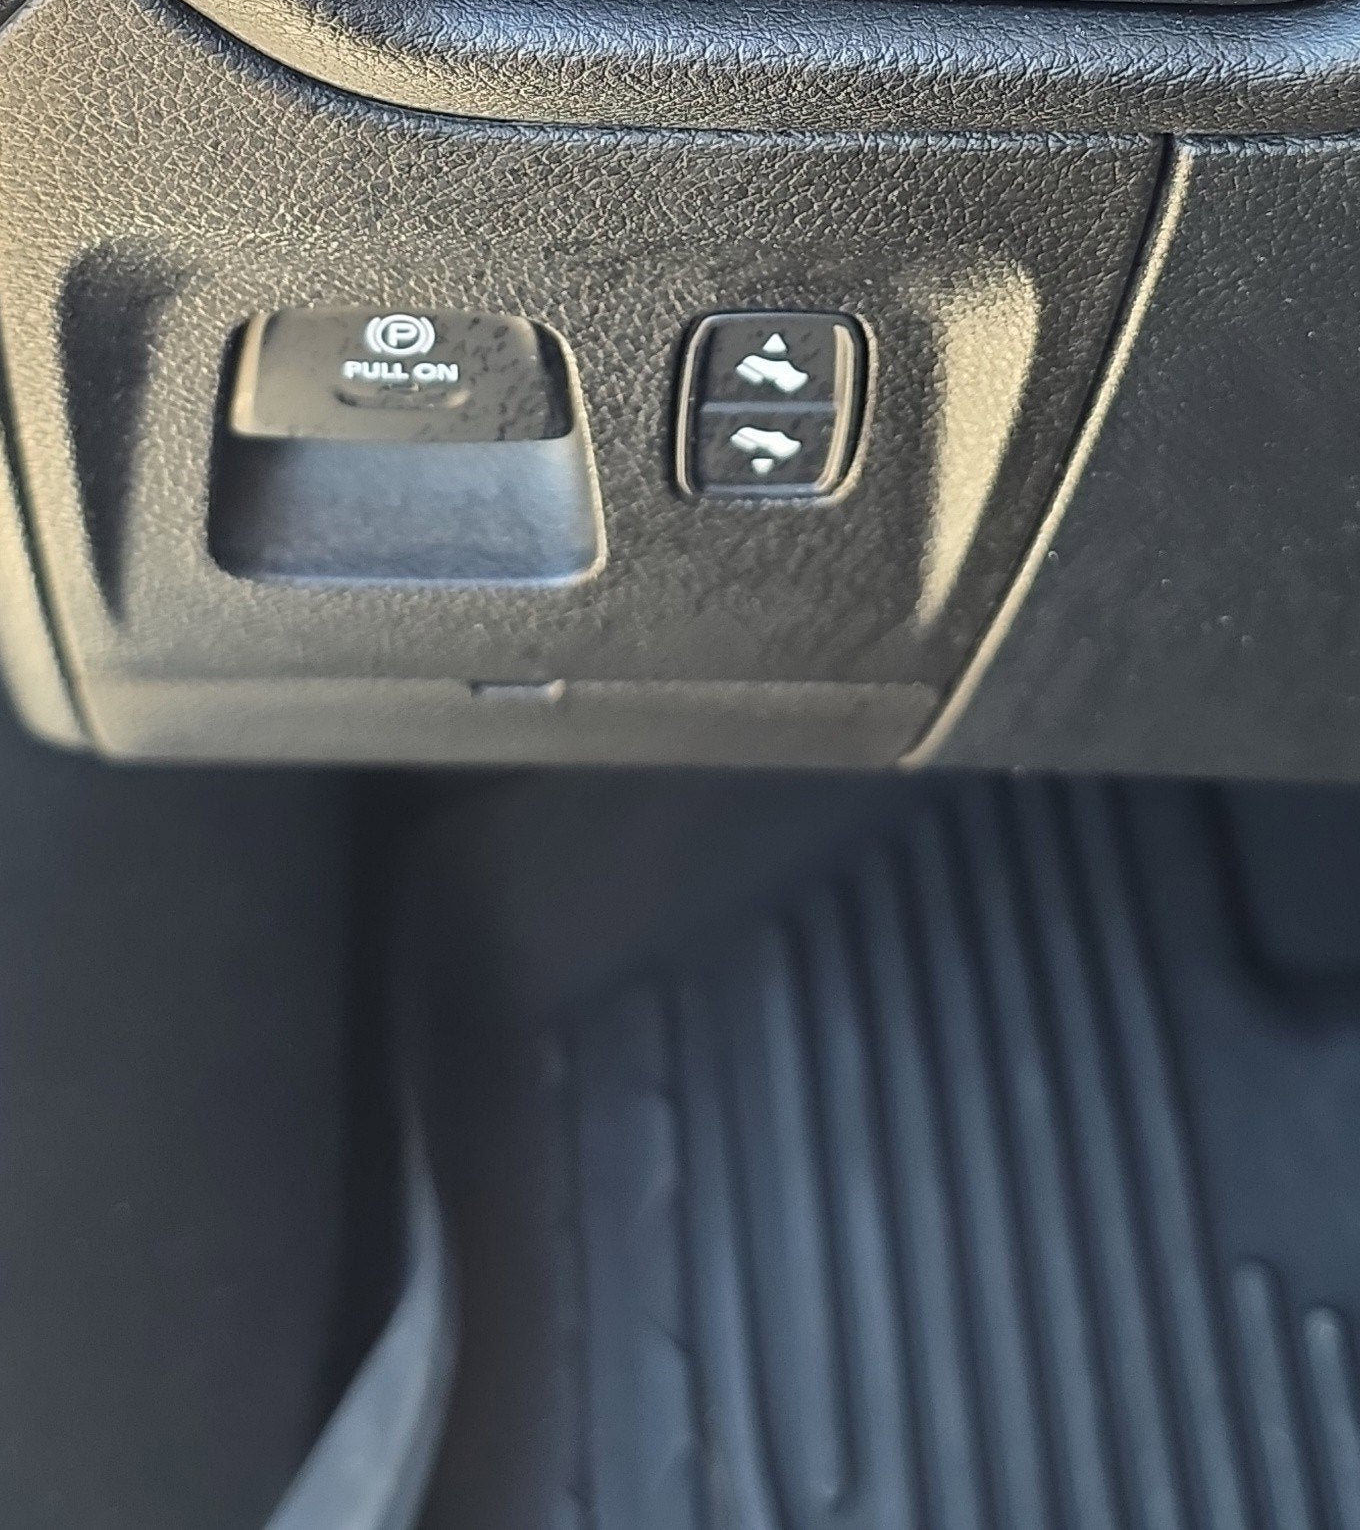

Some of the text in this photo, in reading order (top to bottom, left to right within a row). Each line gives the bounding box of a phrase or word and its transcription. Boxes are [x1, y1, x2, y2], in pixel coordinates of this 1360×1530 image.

[387, 322, 418, 347] P
[343, 360, 459, 382] PULL ON
